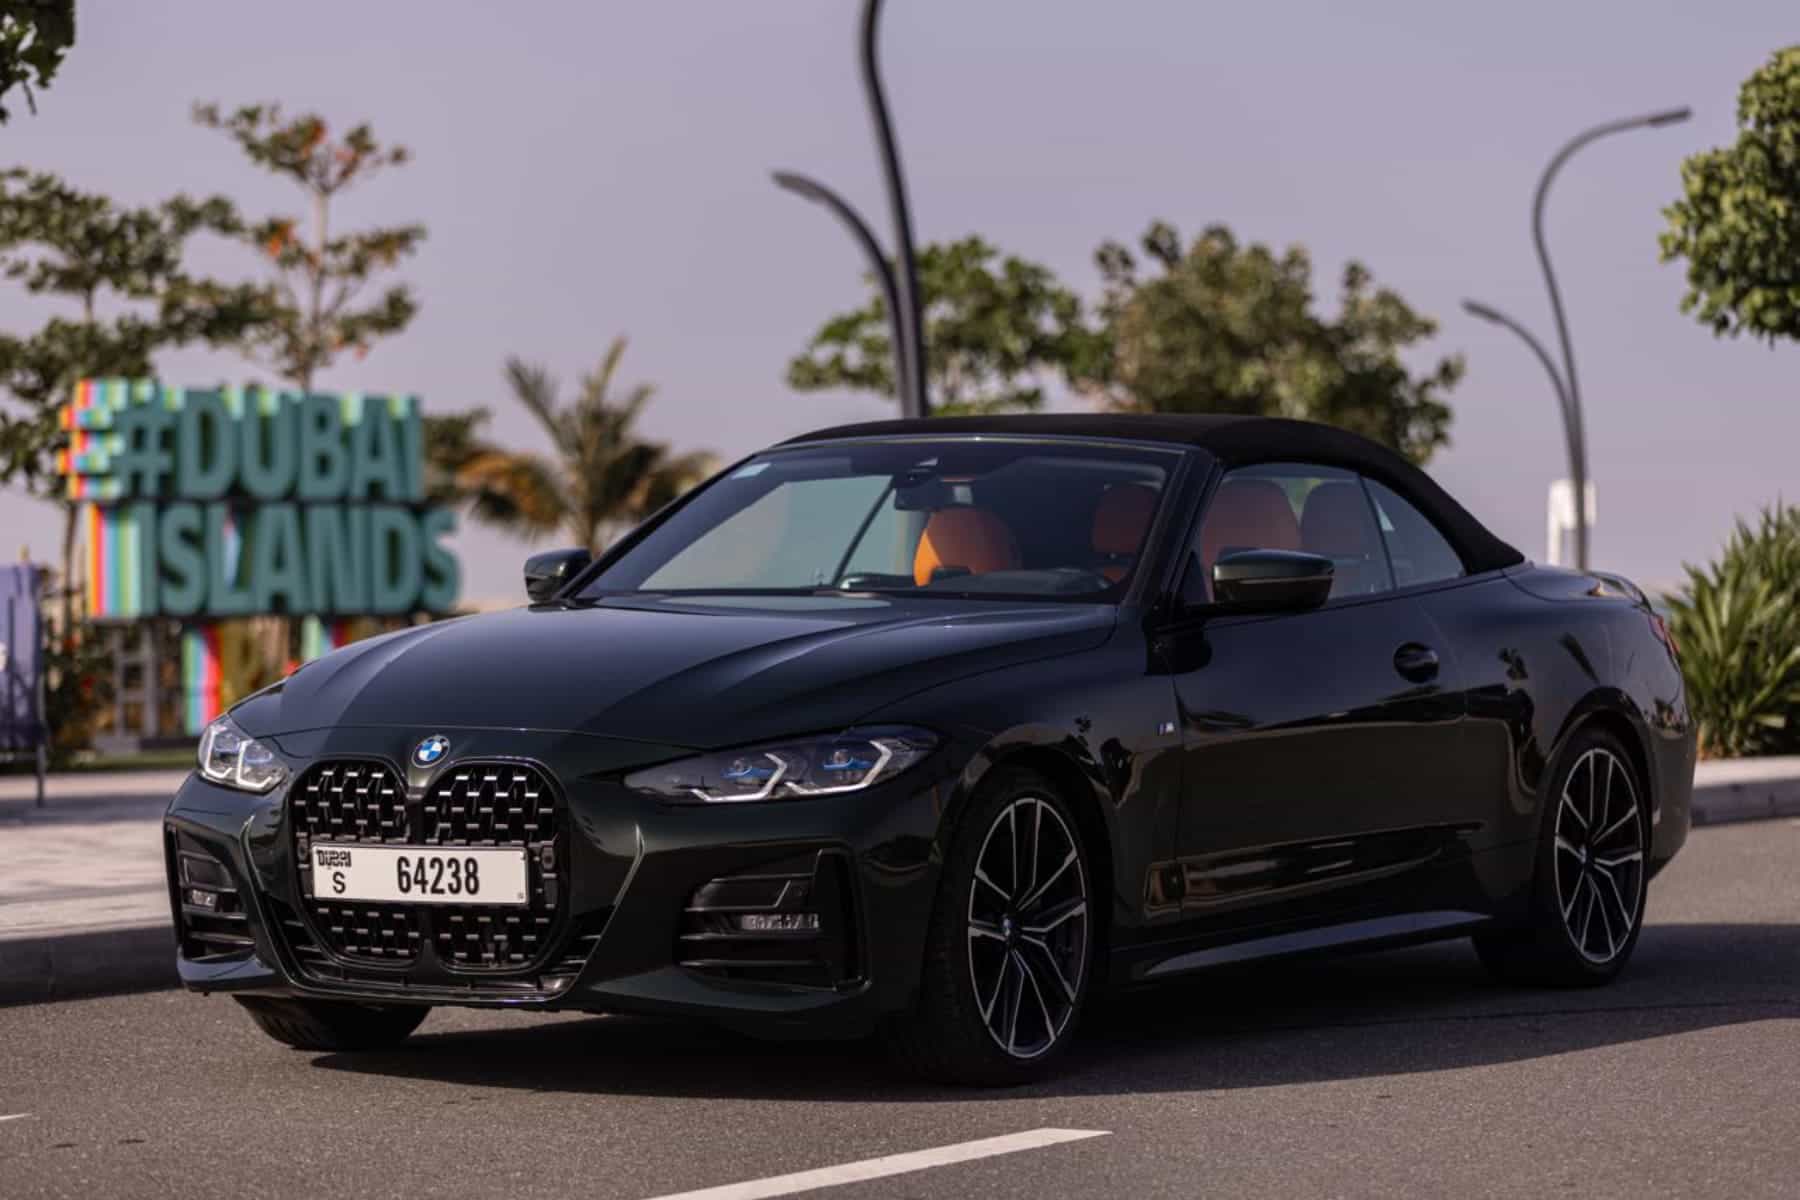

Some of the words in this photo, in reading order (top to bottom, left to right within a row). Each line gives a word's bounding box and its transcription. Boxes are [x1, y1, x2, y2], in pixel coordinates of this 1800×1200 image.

[112, 388, 425, 500] #DUBAI
[137, 502, 461, 616] ISLANDS
[332, 871, 346, 894] S
[396, 856, 480, 895] 64238
